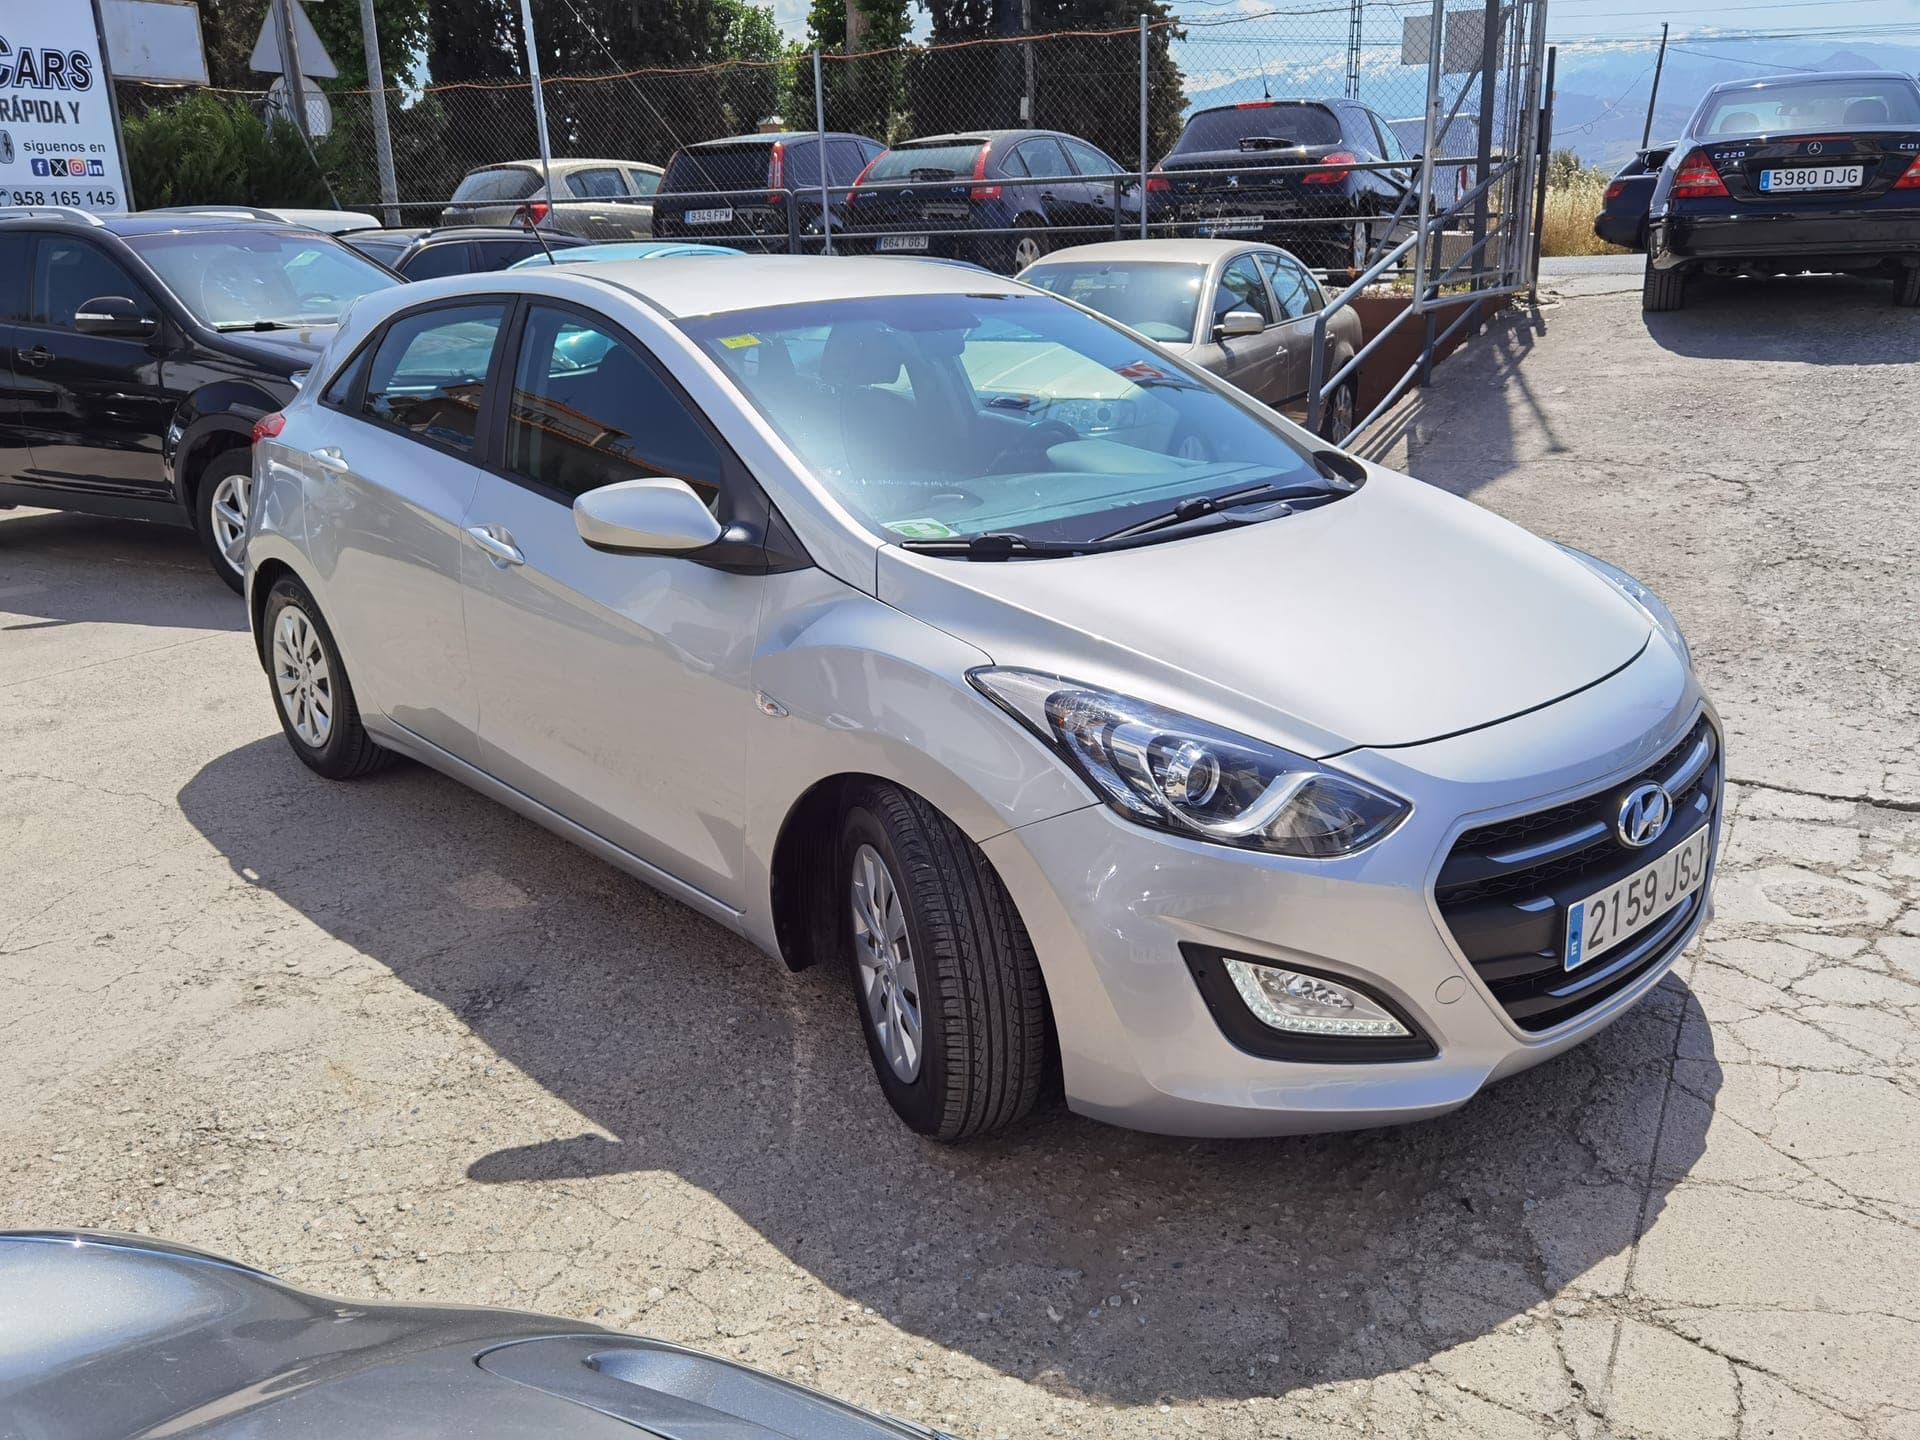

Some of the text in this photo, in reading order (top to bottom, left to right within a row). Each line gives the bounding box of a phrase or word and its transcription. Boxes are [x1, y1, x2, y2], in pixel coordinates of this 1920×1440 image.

[0, 95, 80, 124] RÁPIDA Y
[89, 143, 106, 153] en
[1773, 168, 1858, 186] 5980 DJG
[12, 191, 116, 206] 958 165 145
[1588, 835, 1705, 950] 2159 JSJ
